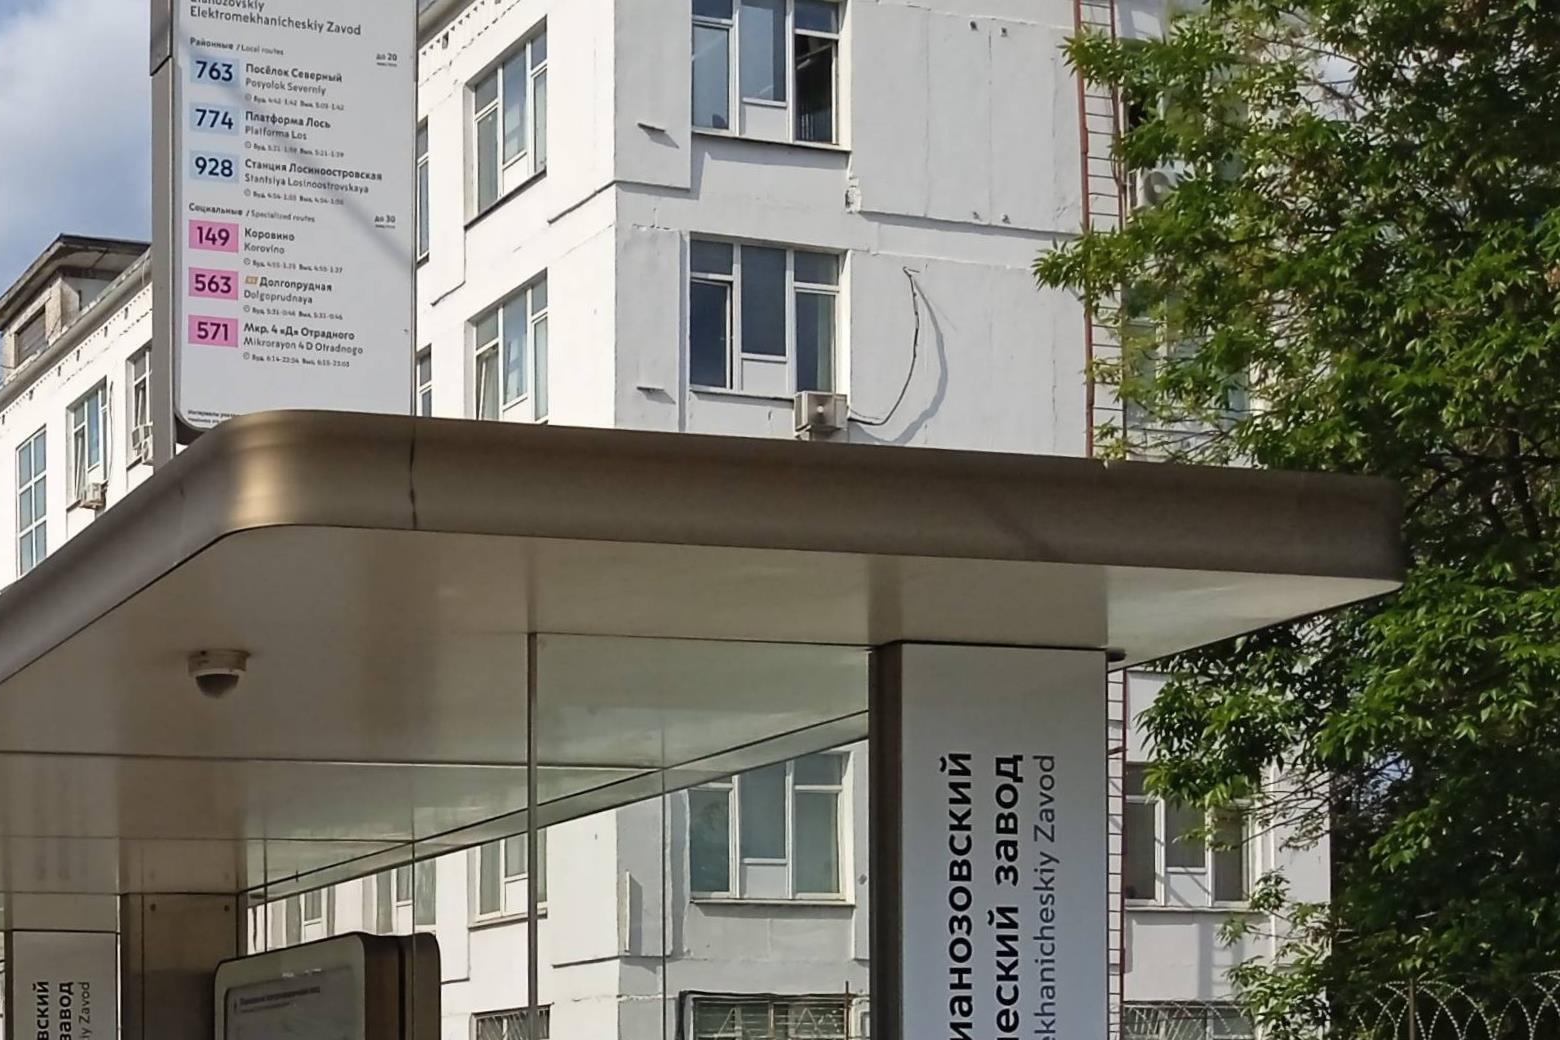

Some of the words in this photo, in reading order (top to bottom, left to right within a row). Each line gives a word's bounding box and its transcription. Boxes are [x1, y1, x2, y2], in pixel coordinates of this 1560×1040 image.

[190, 6, 324, 33] Elektromekhanicheskiy
[326, 21, 361, 35] Zavod
[195, 60, 234, 82] 763
[245, 63, 289, 77] Посёлок
[291, 68, 342, 82] Северный
[245, 77, 286, 91] Posyolok
[194, 109, 234, 130] 774
[245, 111, 304, 126] Платформа
[306, 117, 331, 128] Лось
[194, 156, 233, 178] 928
[244, 159, 287, 173] Станция
[196, 226, 230, 246] 149
[244, 228, 295, 241] Коровино
[244, 242, 285, 254] Korovino
[194, 273, 232, 294] 563
[259, 277, 332, 292] Долгопрудная
[243, 290, 313, 305] Dolgoprudnaya
[196, 321, 229, 342] 571
[243, 323, 269, 334] Мкр.
[271, 325, 278, 334] 4
[301, 327, 355, 340] Отрадного
[243, 336, 296, 350] Mikrorayon
[299, 341, 304, 350] 4
[306, 341, 313, 351] D
[1033, 754, 1057, 843] Zavod
[993, 754, 1024, 887] завод
[78, 981, 91, 1025] Zavod
